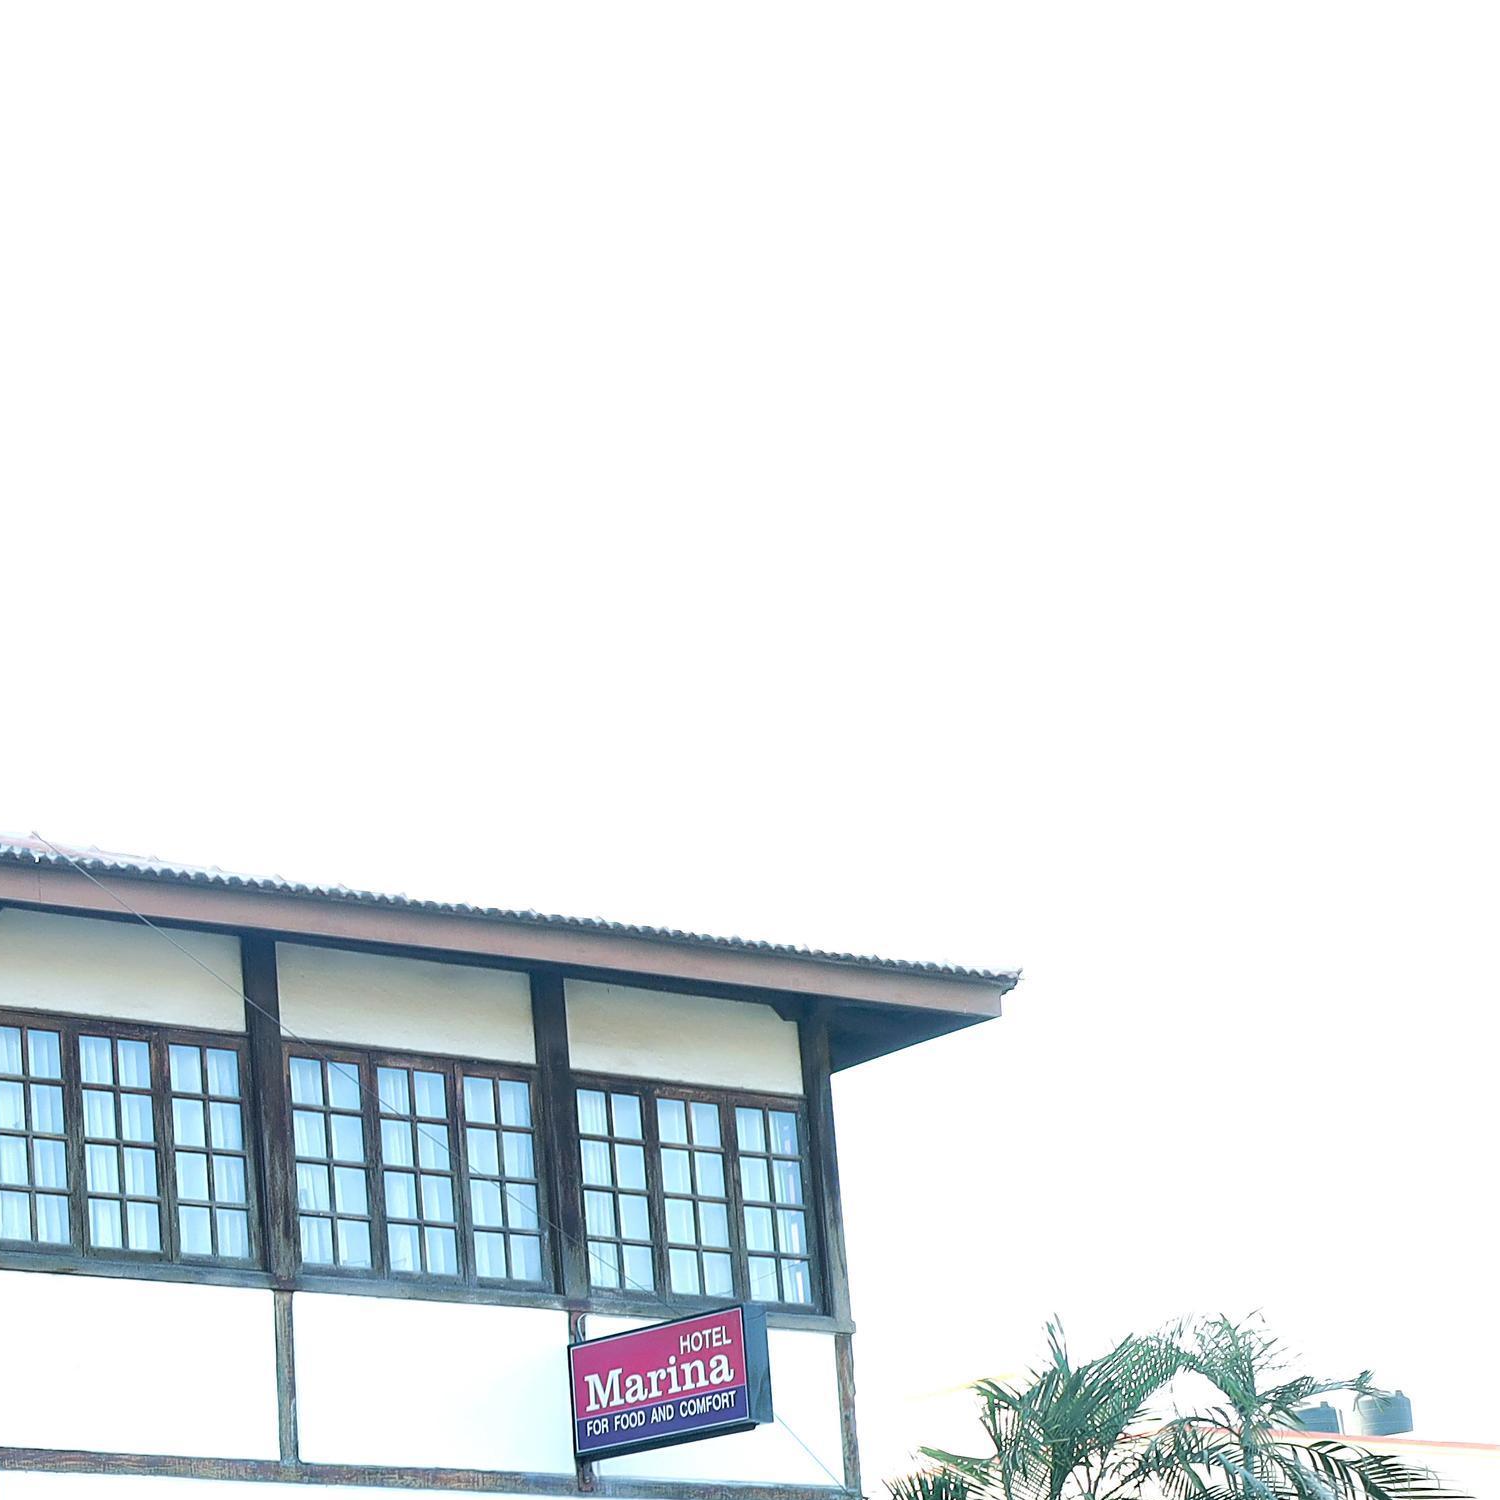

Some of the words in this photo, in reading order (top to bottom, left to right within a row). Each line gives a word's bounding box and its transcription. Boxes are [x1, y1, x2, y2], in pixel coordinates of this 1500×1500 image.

[679, 1325, 732, 1355] HOTEL
[584, 1353, 736, 1413] Marina
[586, 1419, 609, 1437] FOR
[614, 1412, 646, 1432] FOOD
[650, 1406, 674, 1424] AND
[679, 1390, 737, 1417] COMFORT
